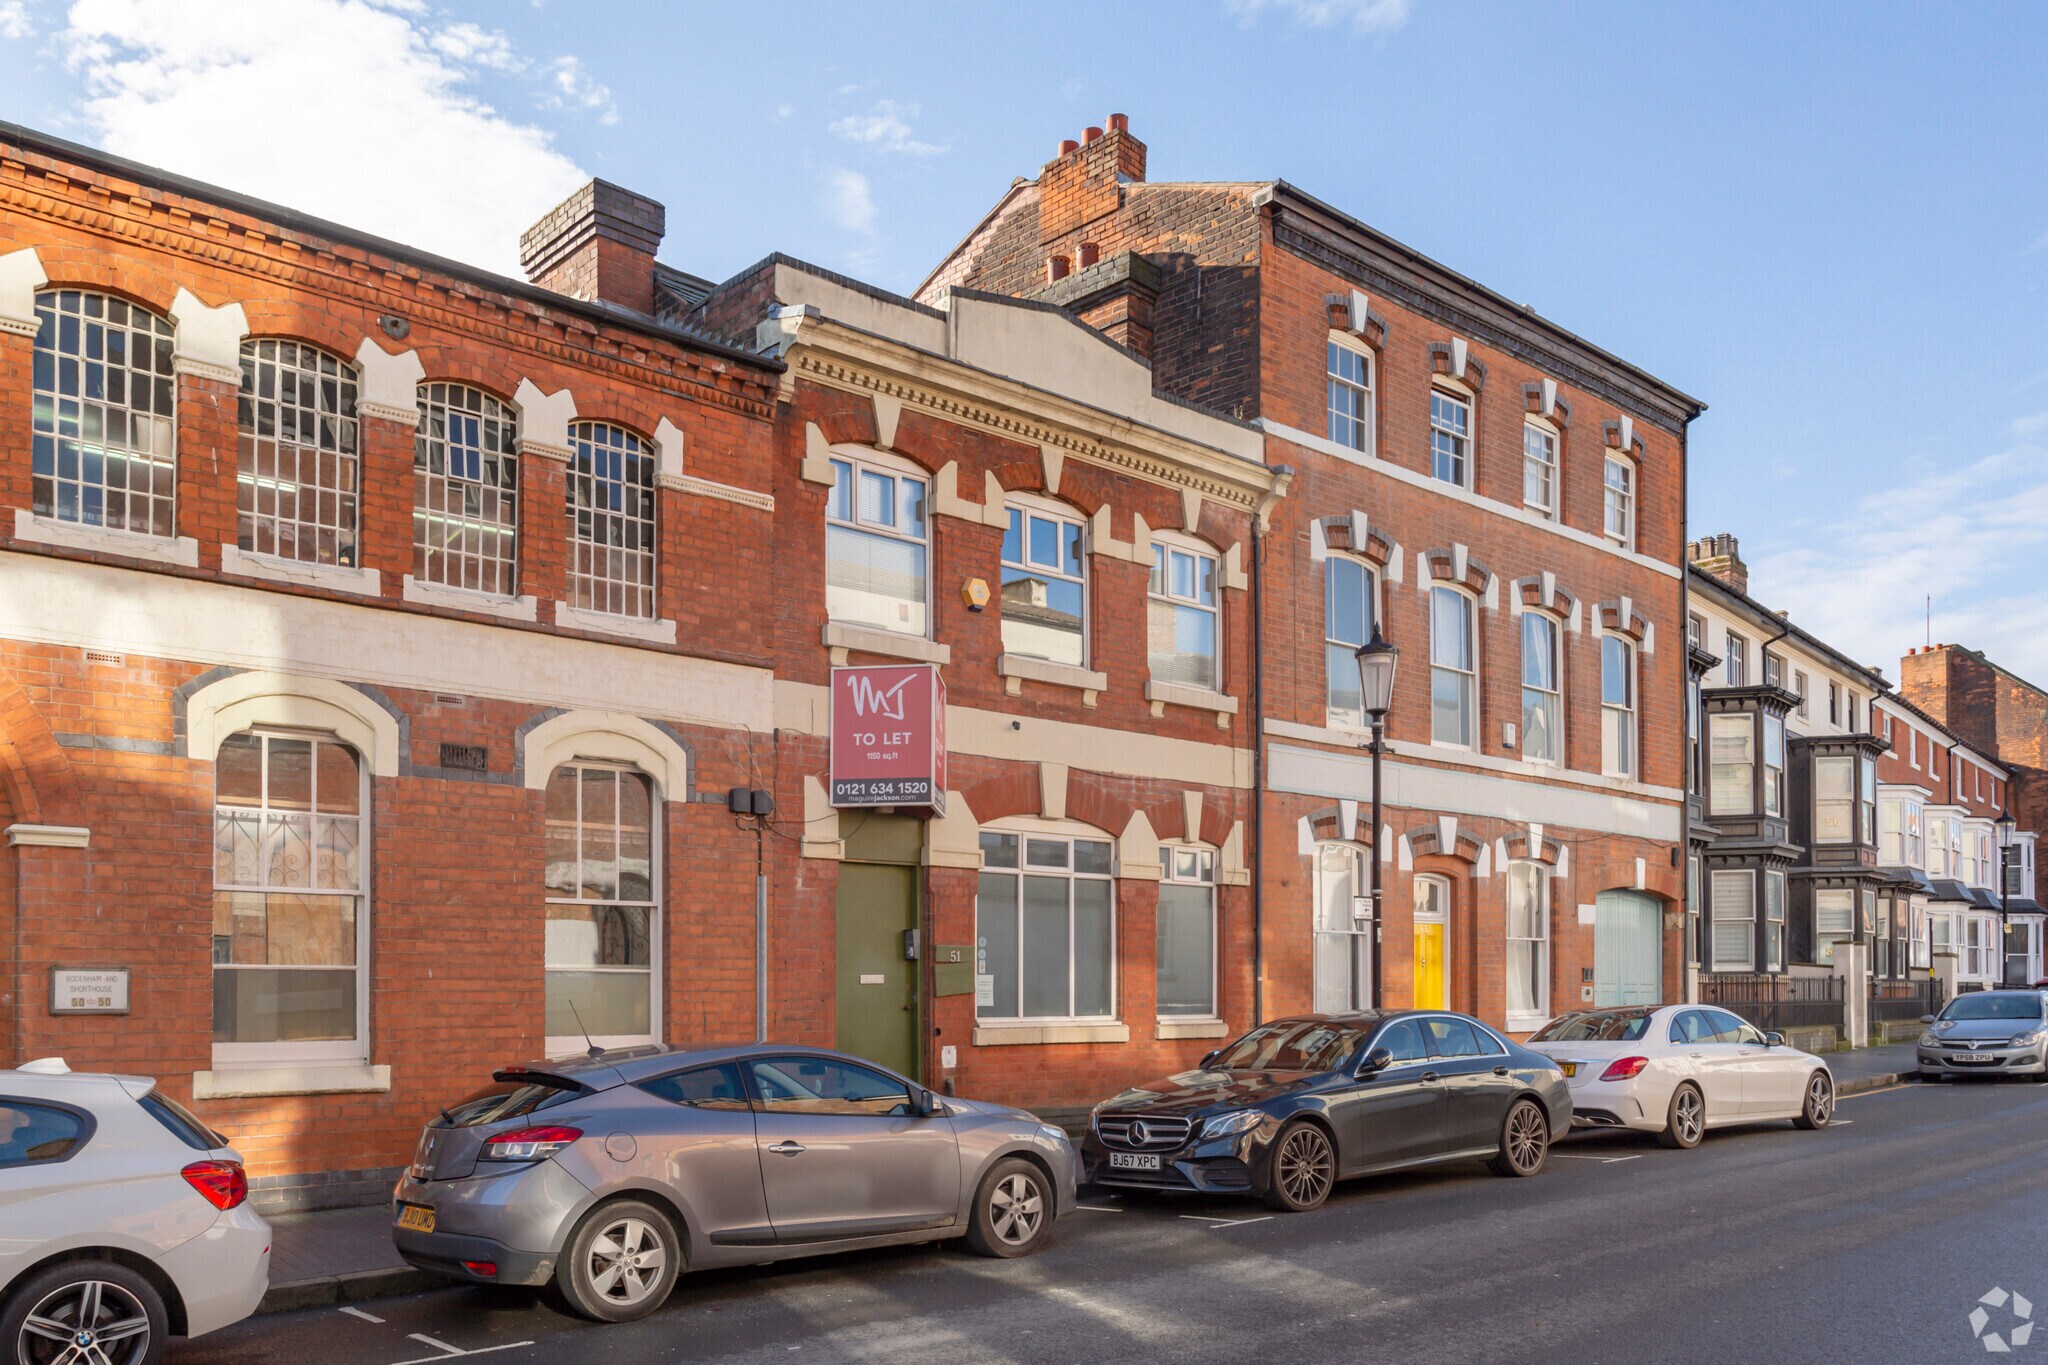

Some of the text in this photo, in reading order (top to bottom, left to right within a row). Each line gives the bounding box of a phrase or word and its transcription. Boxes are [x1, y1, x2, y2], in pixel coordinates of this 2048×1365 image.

[853, 732, 912, 746] TO LET
[866, 752, 881, 760] 1150
[836, 782, 928, 795] 0121 634 1520
[848, 794, 916, 803] maguirejackson.com
[1825, 816, 1841, 826] 56
[950, 950, 961, 962] 51
[1825, 947, 1832, 957] 5
[66, 975, 118, 983] BODENHAM AND
[70, 985, 113, 993] SHORTHOUSE
[1113, 1154, 1157, 1168] BJ67 XPC
